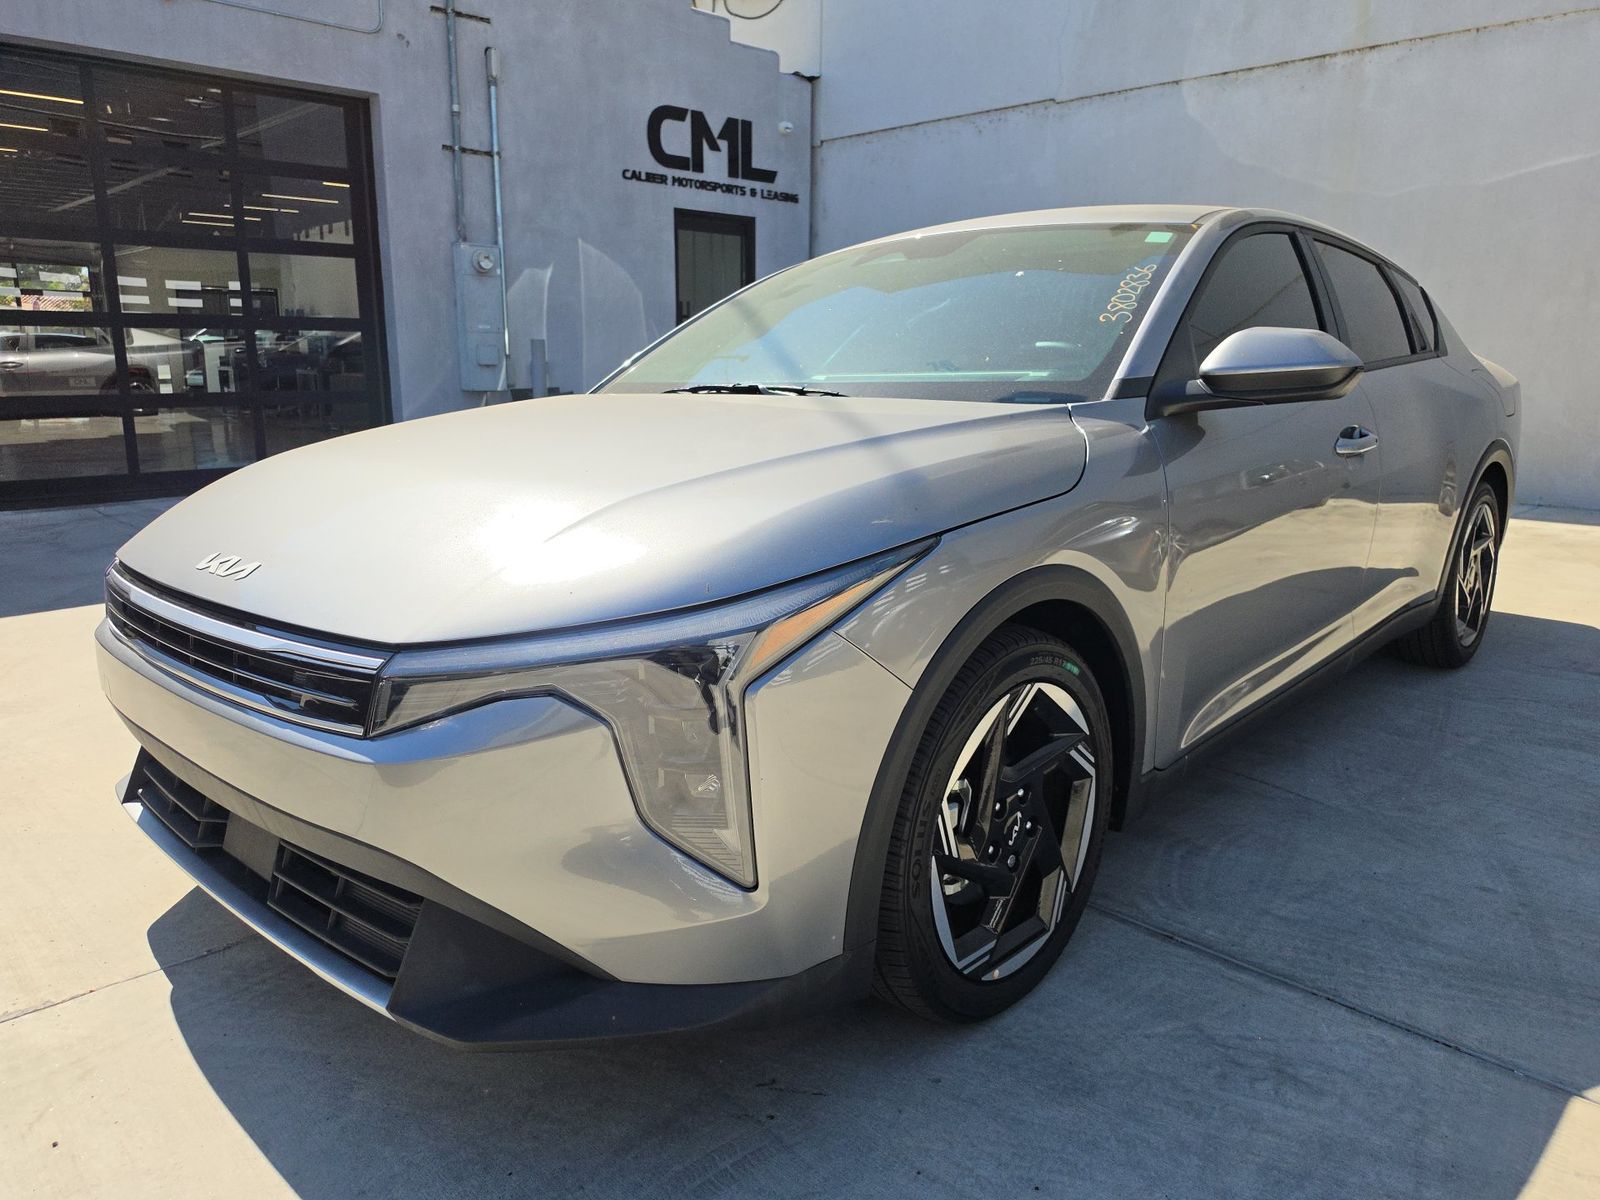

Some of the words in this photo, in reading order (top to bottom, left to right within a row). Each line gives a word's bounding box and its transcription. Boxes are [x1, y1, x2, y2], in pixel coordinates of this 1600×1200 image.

[647, 105, 778, 184] CML
[622, 169, 668, 186] CALIBER
[672, 176, 746, 196] MOTORSPORTS
[750, 188, 757, 198] &
[761, 189, 799, 203] LEASING
[1099, 264, 1157, 323] 3802836
